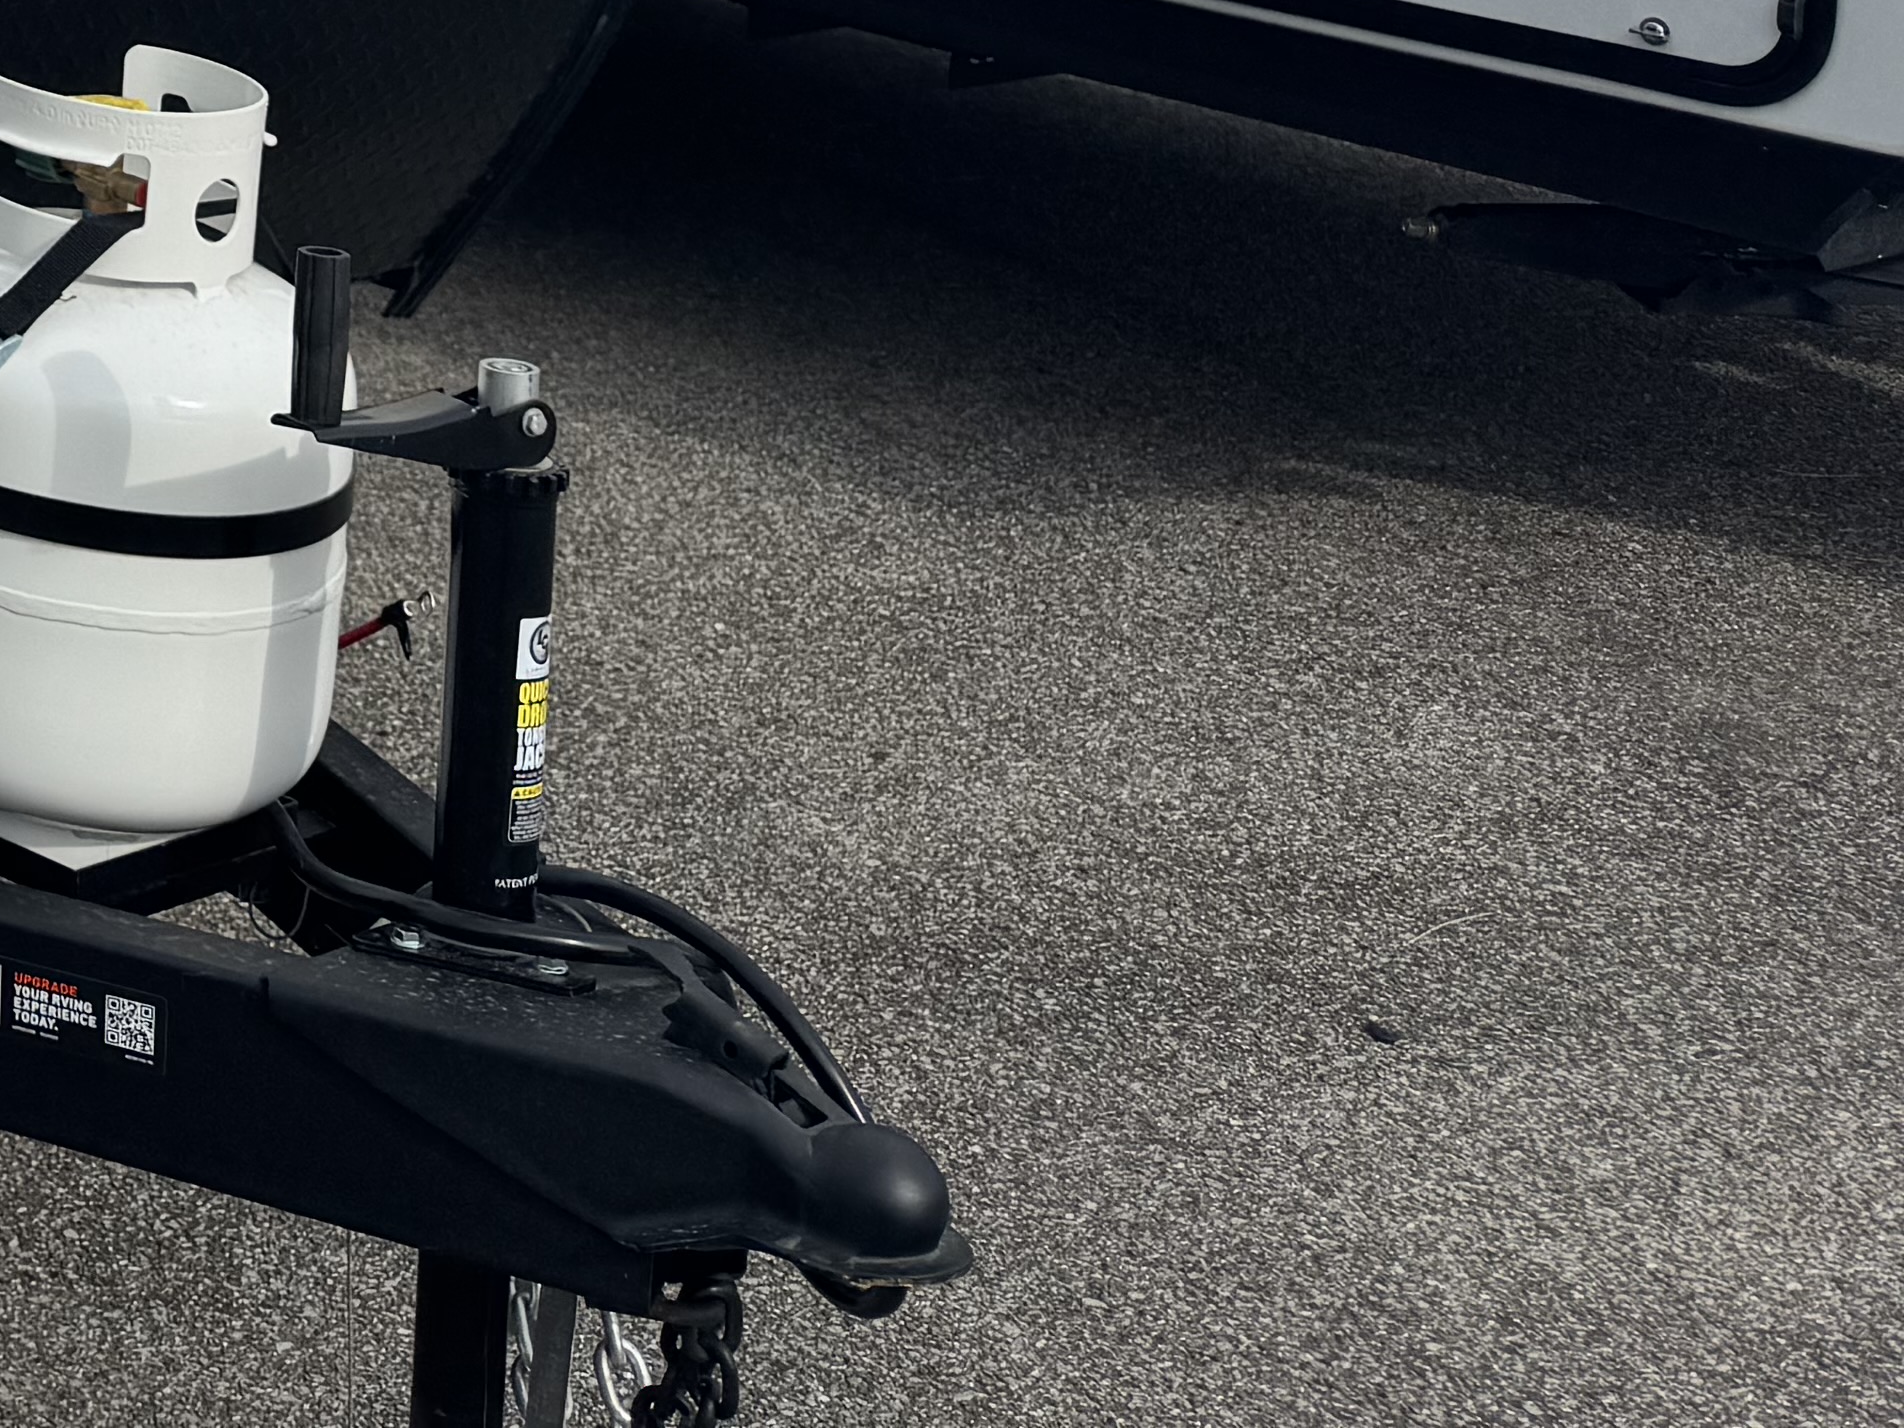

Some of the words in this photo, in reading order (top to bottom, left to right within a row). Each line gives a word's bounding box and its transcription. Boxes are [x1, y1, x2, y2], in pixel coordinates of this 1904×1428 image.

[519, 678, 550, 705] QUIC
[514, 744, 544, 771] JAC
[14, 971, 79, 998] UPGRADE
[13, 983, 49, 1003] YOUR
[51, 991, 93, 1014] RVING
[13, 996, 98, 1029] EXPERIENCE
[13, 1008, 59, 1032] TODAY.
